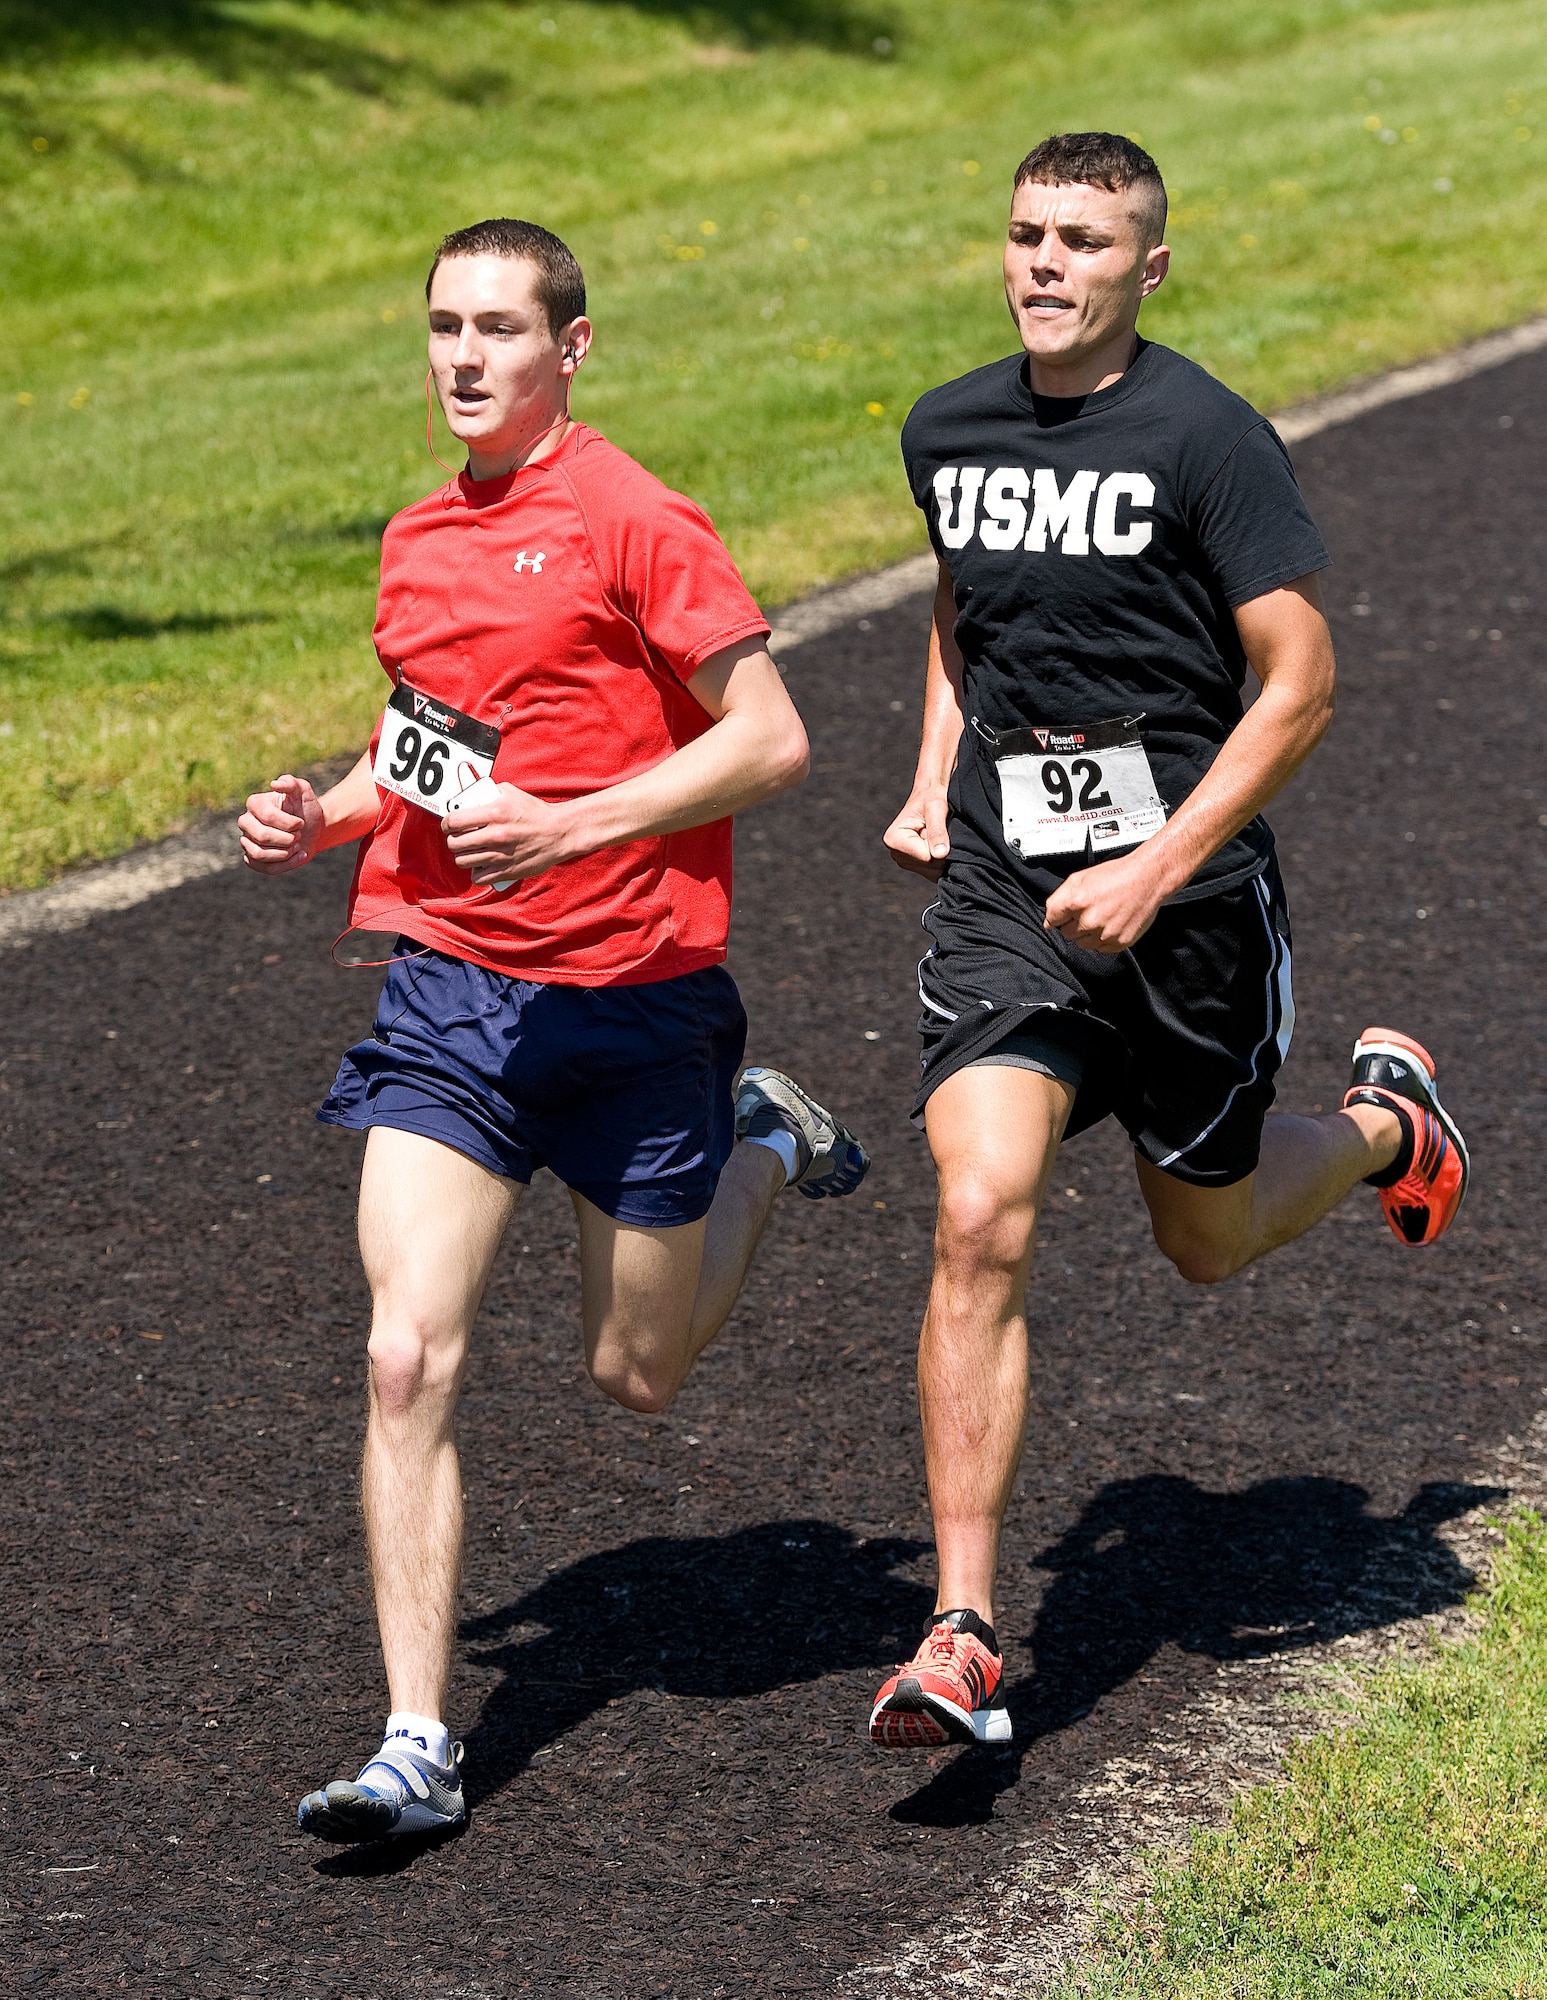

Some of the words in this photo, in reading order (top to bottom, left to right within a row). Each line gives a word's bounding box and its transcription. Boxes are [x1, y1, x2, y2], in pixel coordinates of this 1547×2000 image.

[932, 466, 1157, 556] USMC
[389, 725, 450, 797] 96
[1050, 733, 1086, 745] RoadID
[376, 775, 441, 813] www.RoadID.com
[1041, 758, 1113, 814] 92
[1036, 806, 1125, 825] www.RoadID.com
